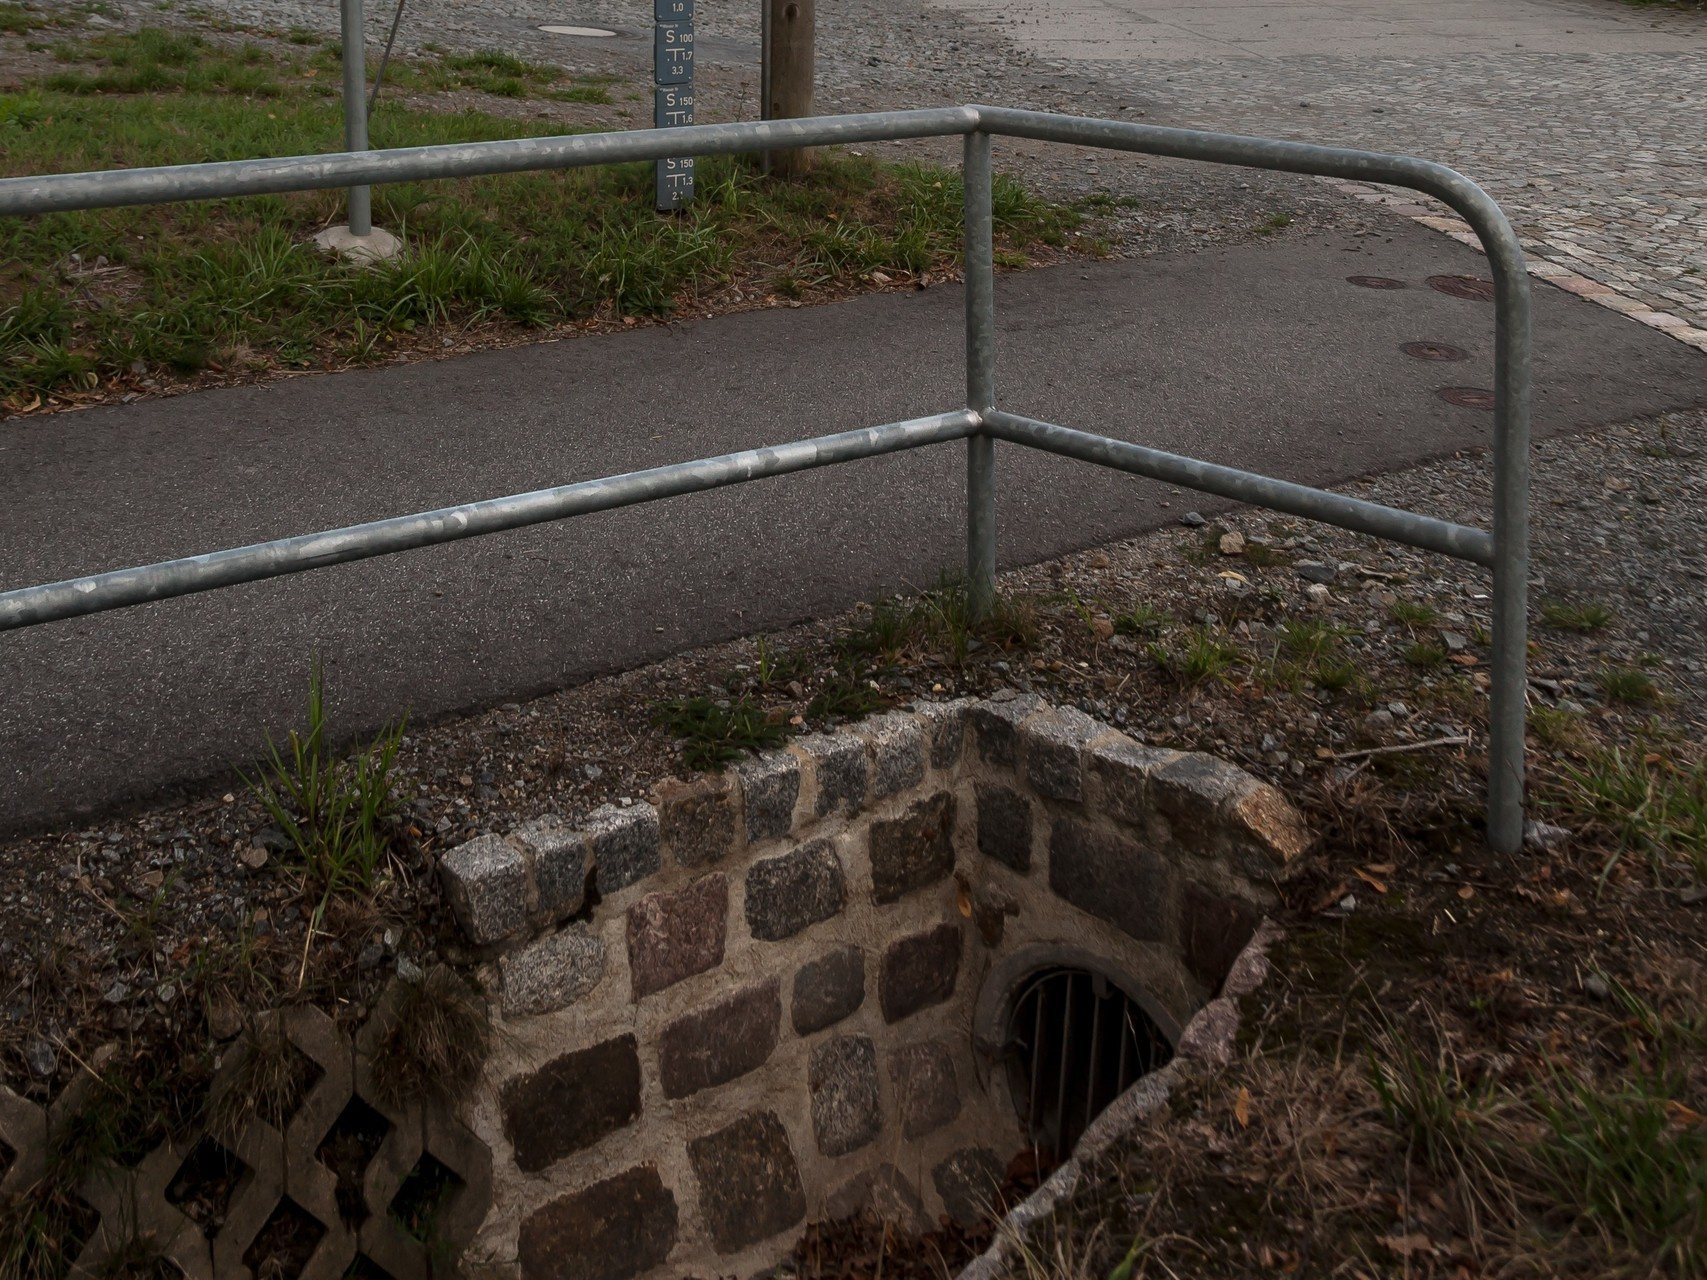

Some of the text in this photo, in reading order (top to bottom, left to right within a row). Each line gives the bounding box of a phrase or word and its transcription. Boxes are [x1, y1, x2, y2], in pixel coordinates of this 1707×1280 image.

[666, 30, 693, 43] S 100
[666, 93, 693, 107] S 150
[667, 158, 694, 169] S 150
